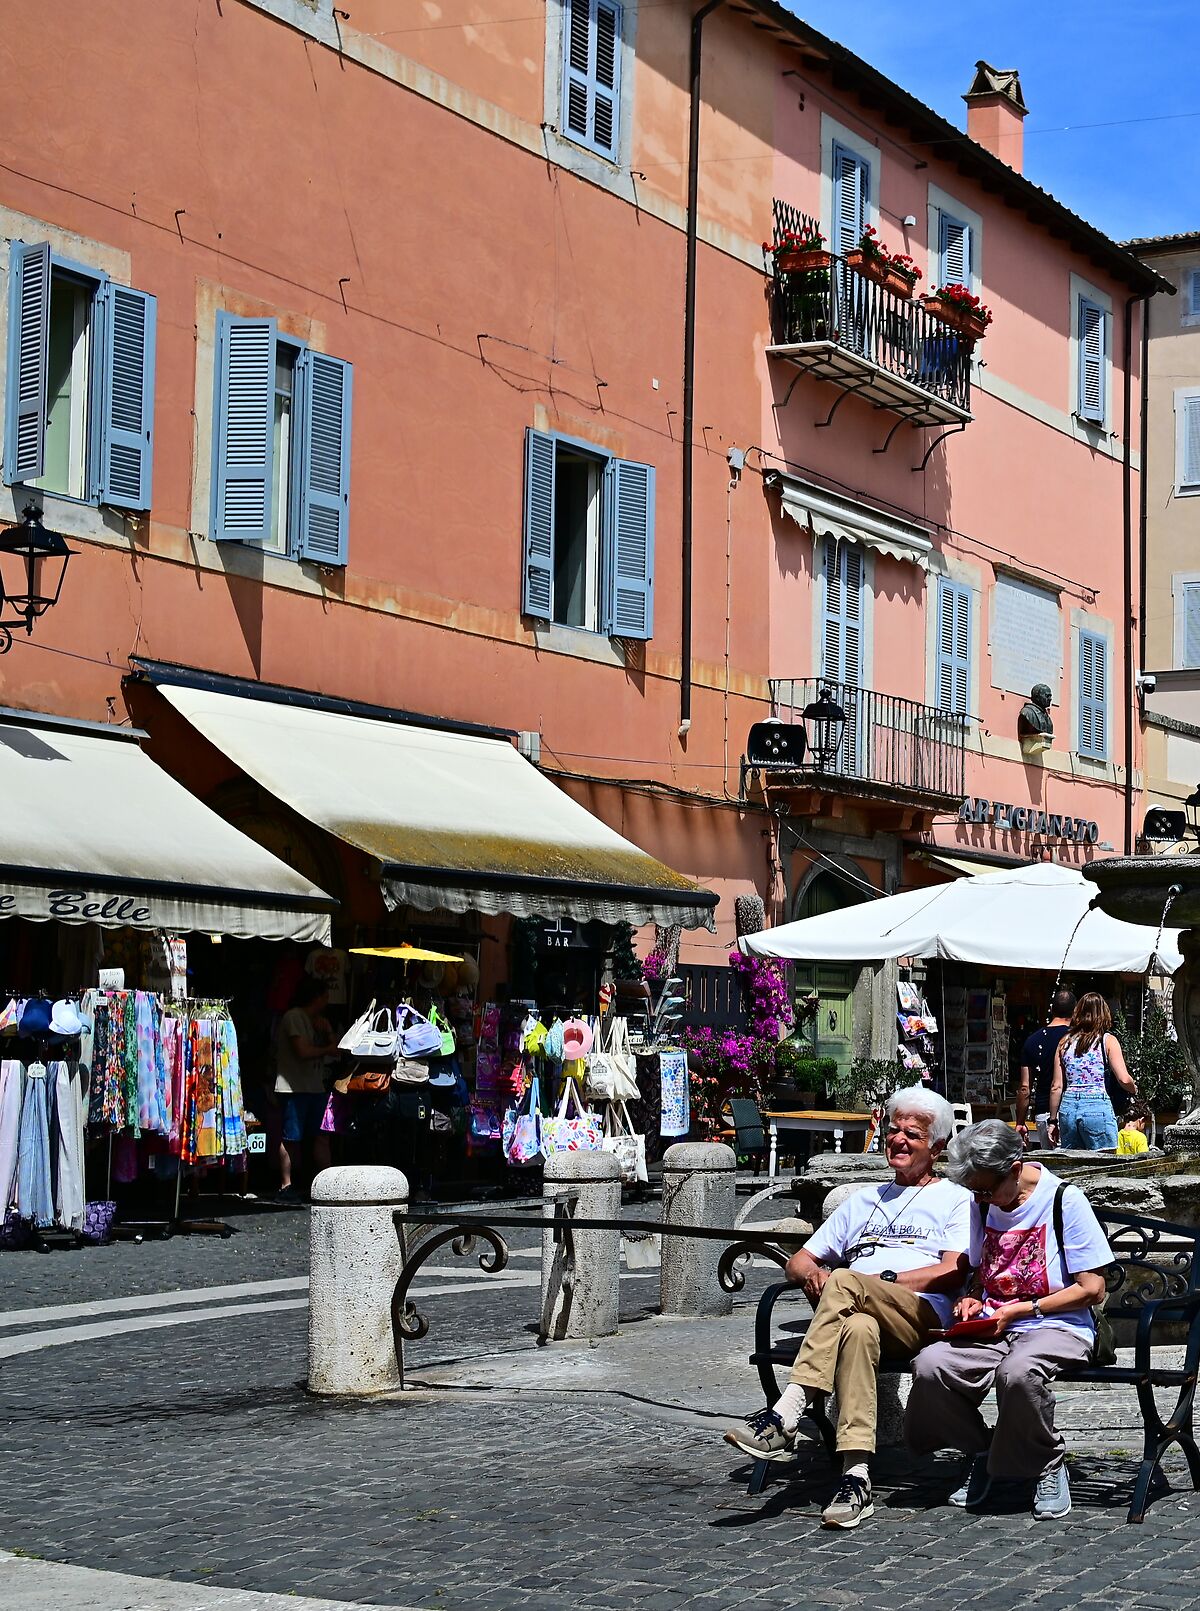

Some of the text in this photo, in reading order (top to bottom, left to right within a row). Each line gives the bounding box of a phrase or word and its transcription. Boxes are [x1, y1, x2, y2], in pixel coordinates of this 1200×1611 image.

[959, 797, 1099, 843] ARTIGIANATO
[0, 889, 151, 922] e Belle
[547, 936, 569, 947] BAR
[249, 1140, 264, 1151] ,00
